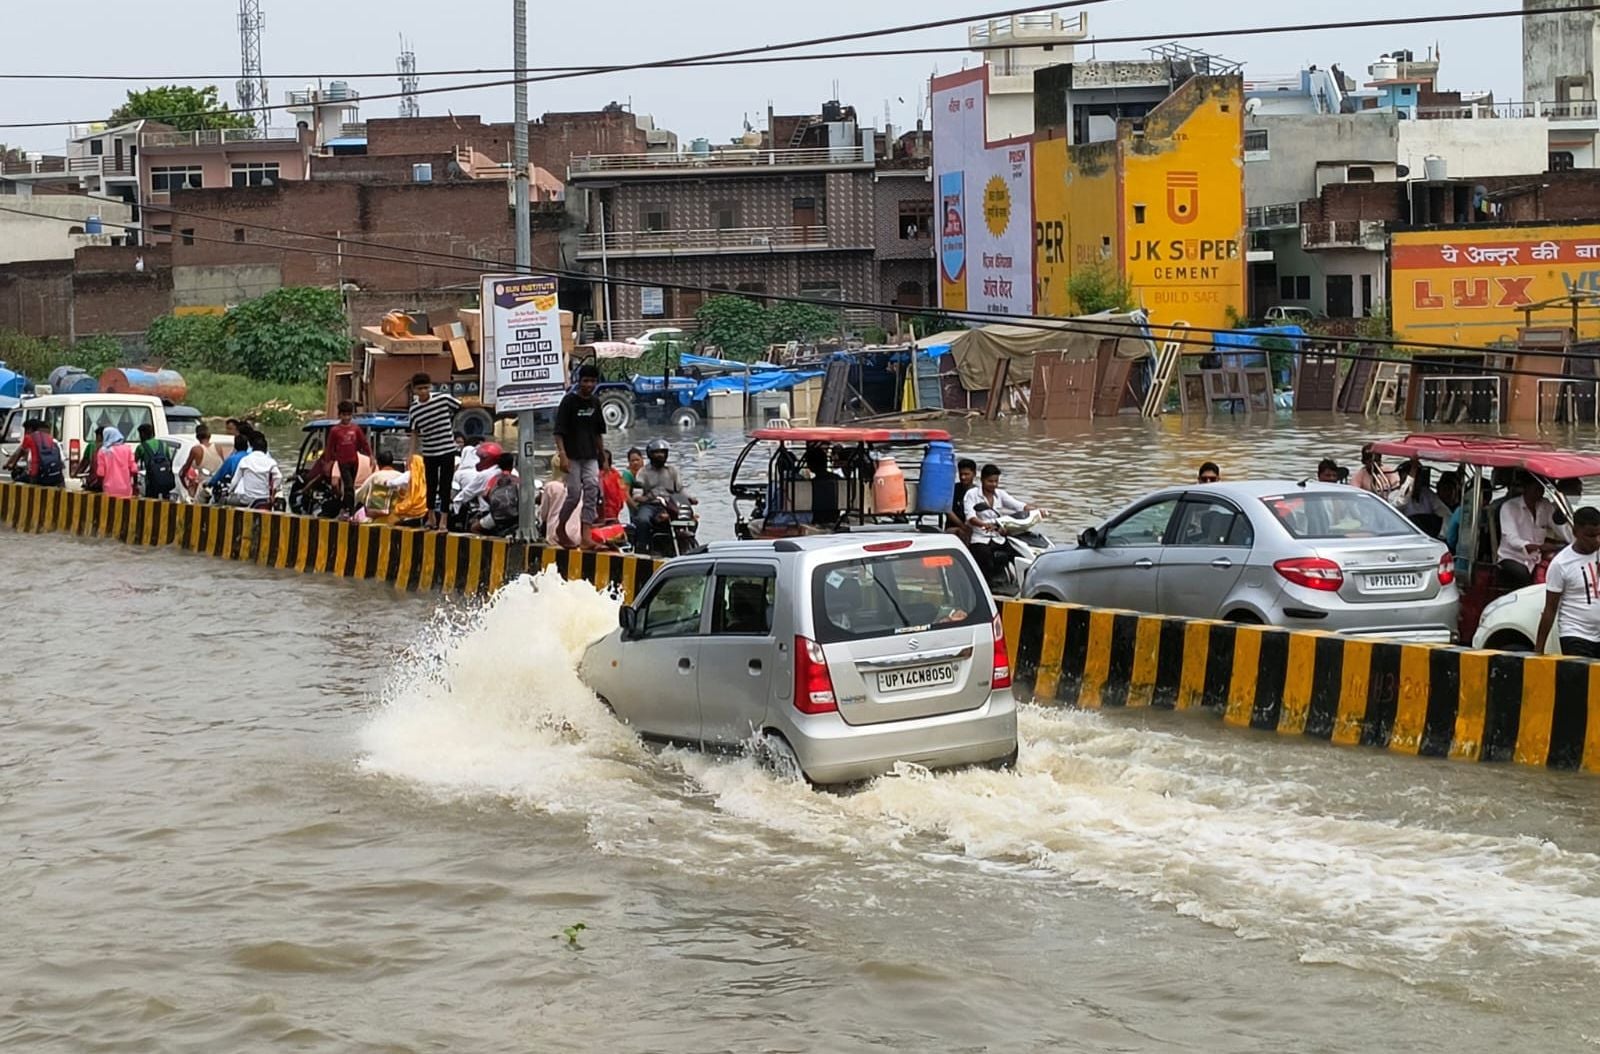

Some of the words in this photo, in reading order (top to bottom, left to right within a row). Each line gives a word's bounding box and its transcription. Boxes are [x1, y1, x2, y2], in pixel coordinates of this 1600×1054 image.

[1441, 244, 1459, 263] ये
[1464, 246, 1519, 266] अन्दर
[1531, 241, 1560, 260] की
[1154, 267, 1219, 280] CEMENT
[521, 282, 555, 291] INSTITUTE
[1413, 275, 1536, 310] LUX
[1155, 291, 1189, 304] BUILD
[1194, 291, 1219, 303] SAFE
[884, 667, 951, 688] UP14CN8050
